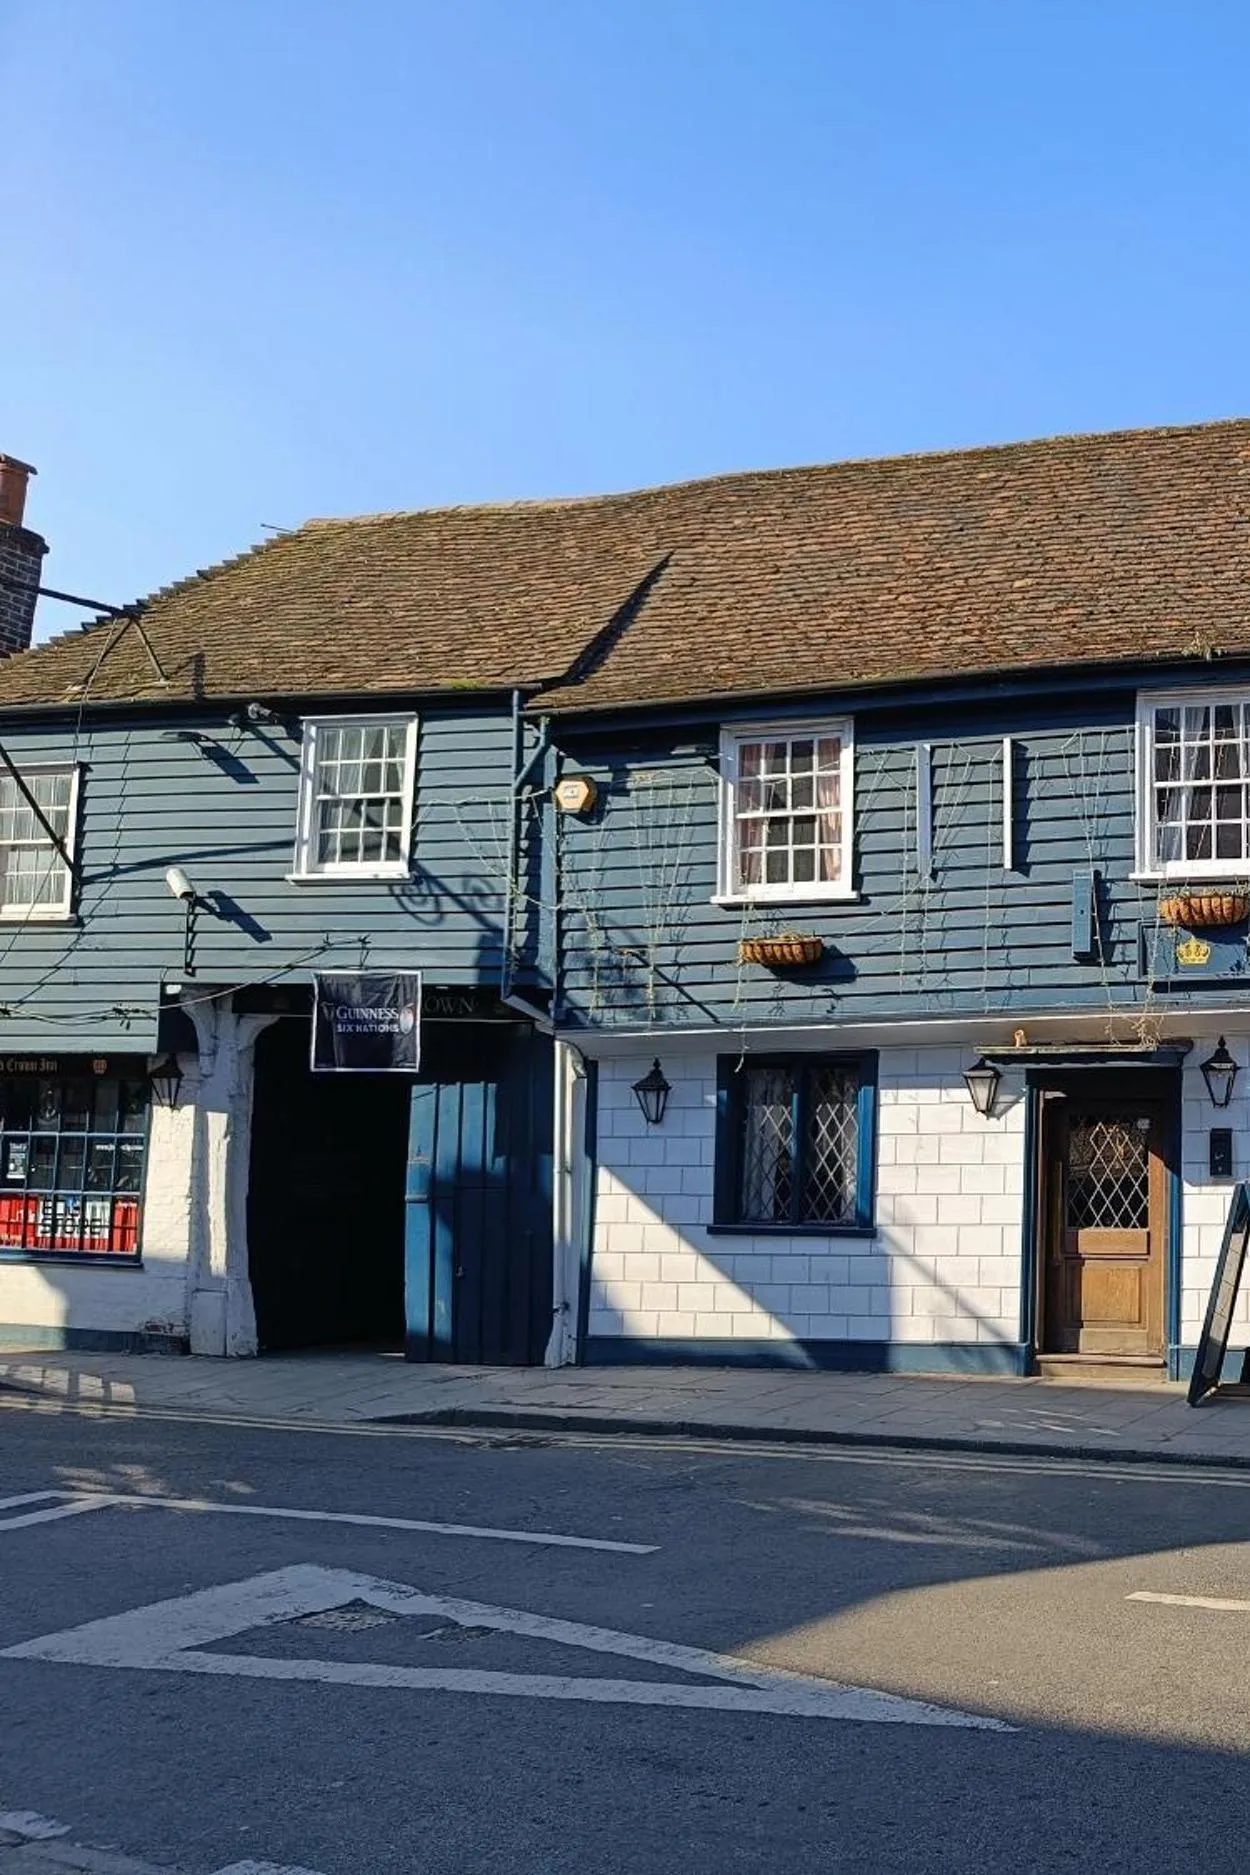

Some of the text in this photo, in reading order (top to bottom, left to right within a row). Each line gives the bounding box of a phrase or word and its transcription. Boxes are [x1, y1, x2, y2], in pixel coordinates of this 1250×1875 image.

[336, 1006, 399, 1021] GUINNESS
[337, 1024, 400, 1033] SIX NATIONS
